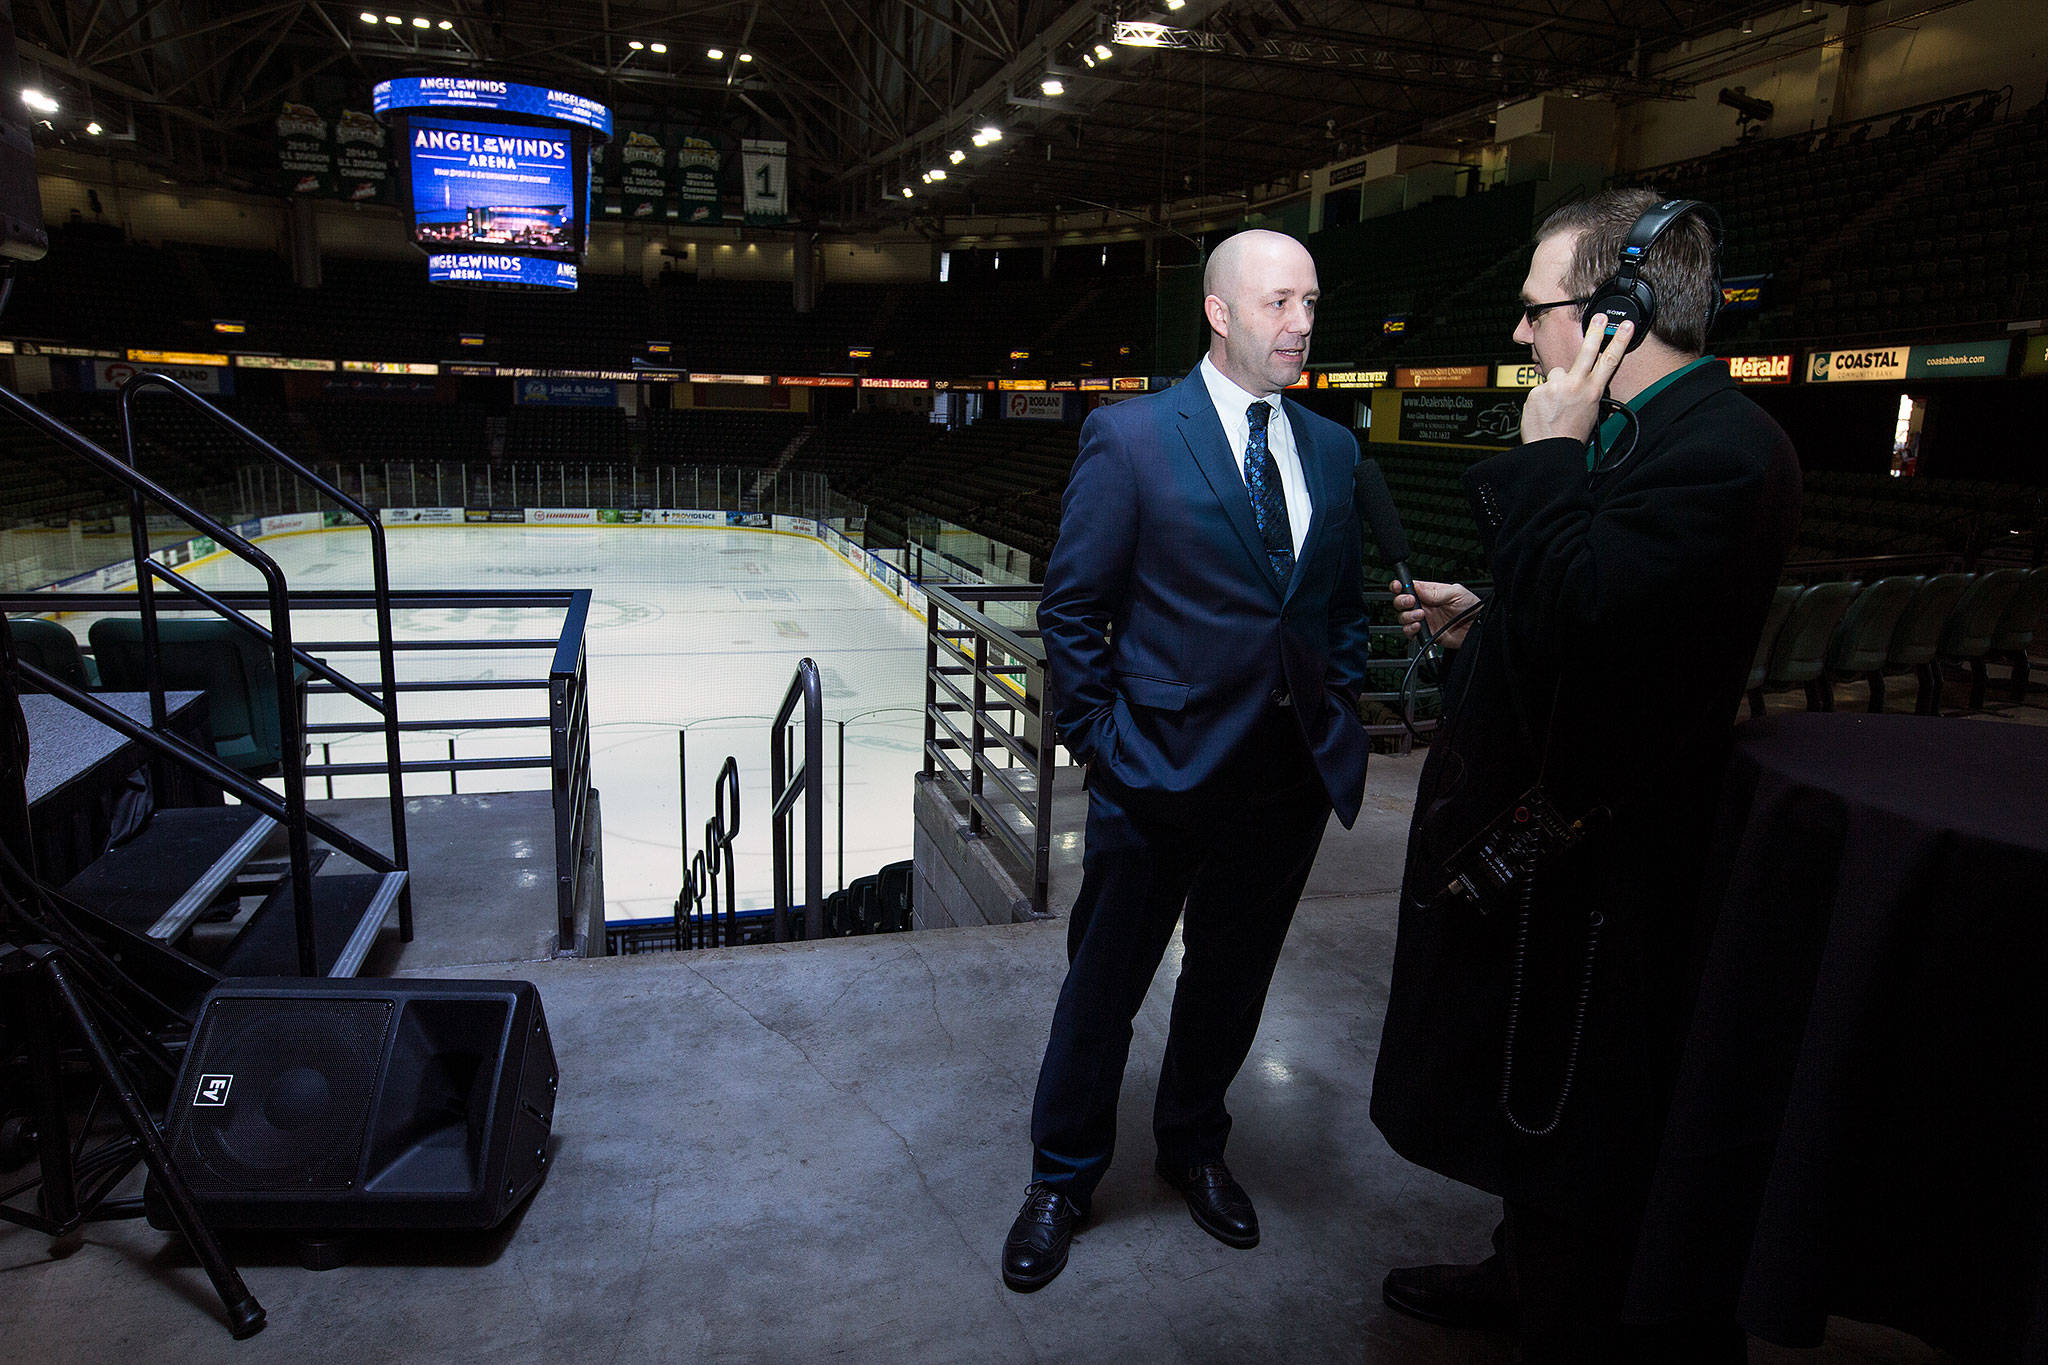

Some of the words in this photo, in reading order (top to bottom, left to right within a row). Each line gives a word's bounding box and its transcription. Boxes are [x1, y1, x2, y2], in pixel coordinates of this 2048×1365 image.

[420, 78, 458, 90] ANGEL
[464, 80, 507, 93] WINDS
[415, 129, 482, 152] ANGEL
[498, 137, 566, 159] WINDS
[468, 154, 517, 169] ARENA
[756, 163, 777, 198] 1
[469, 255, 521, 271] WINDS
[449, 270, 482, 280] ARENA
[1730, 354, 1789, 378] Herald
[1836, 351, 1899, 370] COASTAL
[1926, 355, 1985, 367] coastalbank.com
[1328, 372, 1356, 382] REDHOOK
[1357, 371, 1388, 382] BREWERY
[1837, 370, 1875, 379] COMMUNITY
[1877, 369, 1893, 378] BANK
[861, 378, 890, 388] Klein
[891, 379, 928, 389] Honda
[672, 512, 715, 520] PROVIDENCE
[203, 1080, 226, 1101] EV
